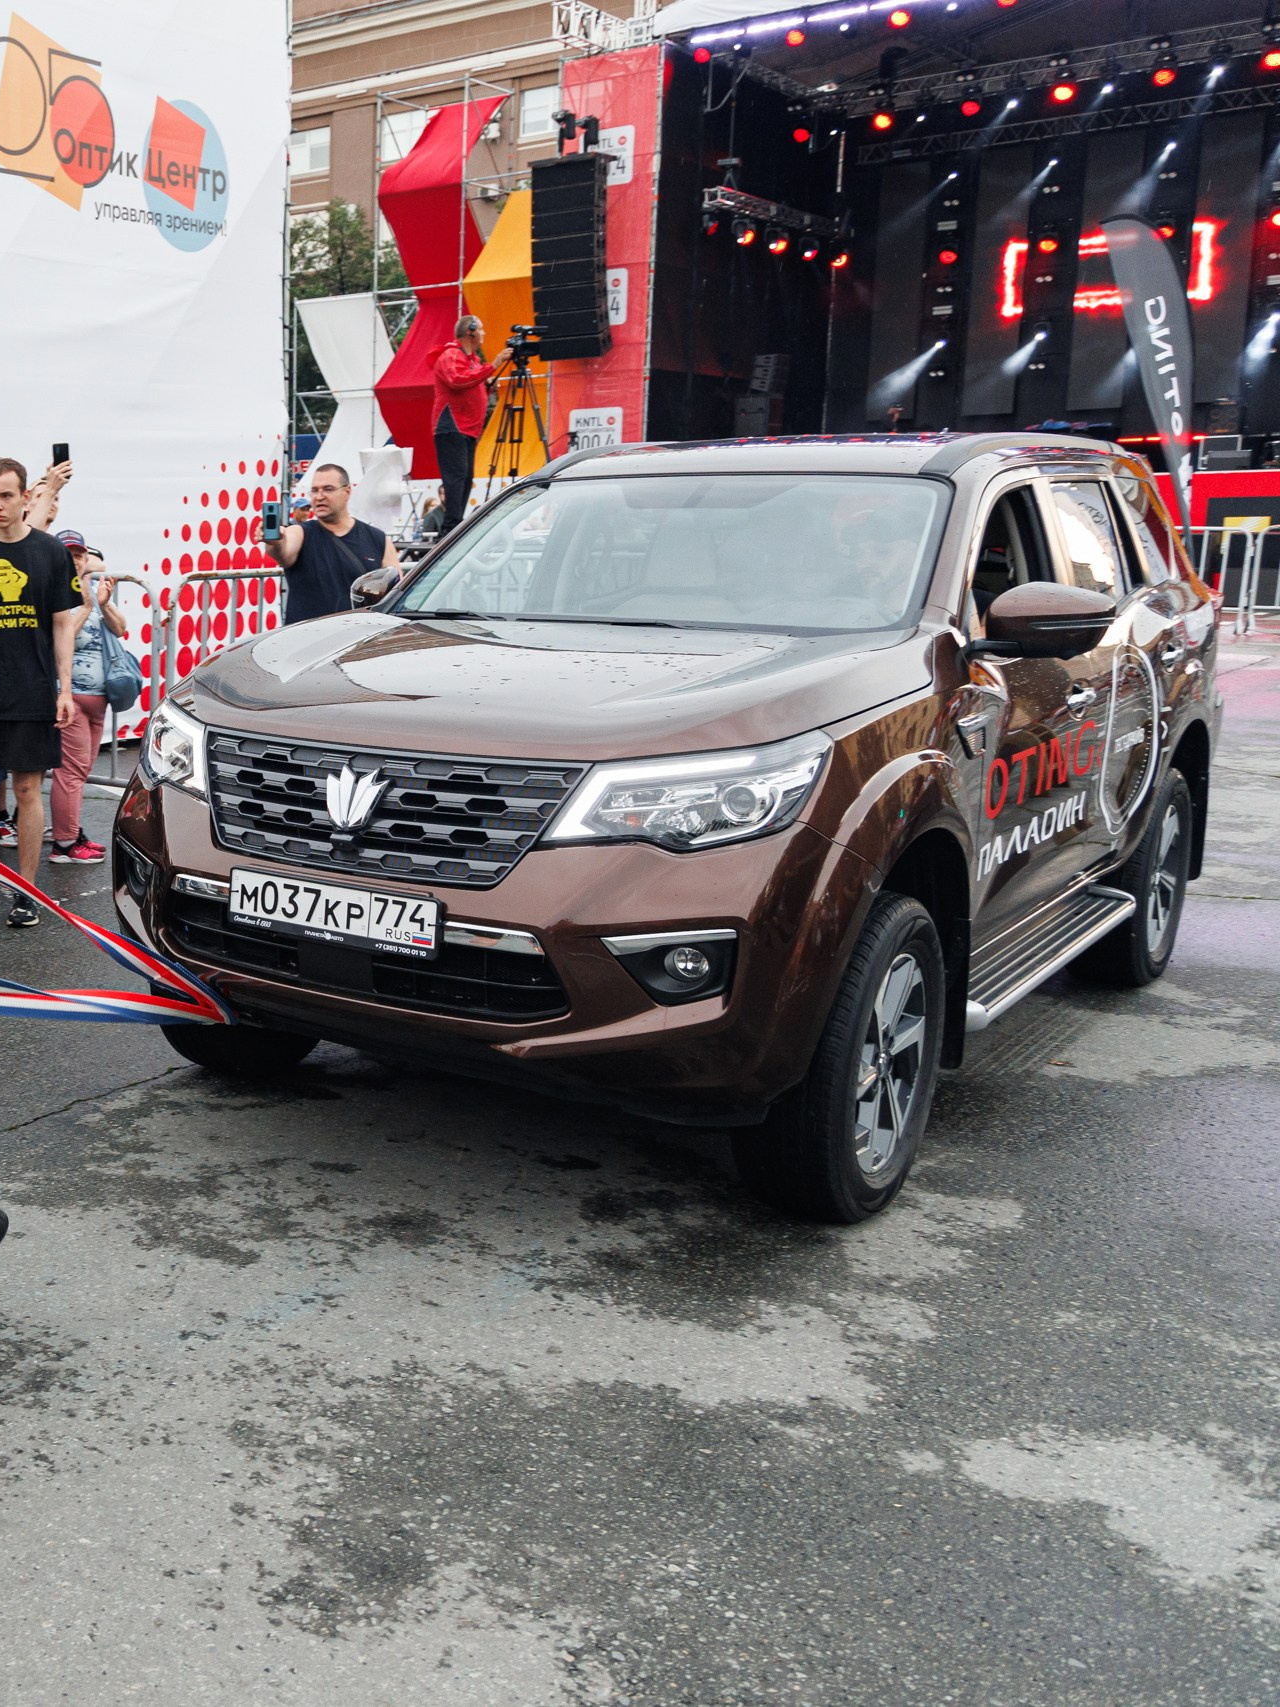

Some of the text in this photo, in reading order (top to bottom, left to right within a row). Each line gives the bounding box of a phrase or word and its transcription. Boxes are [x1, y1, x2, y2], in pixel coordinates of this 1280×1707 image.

[54, 128, 227, 202] Оптик Центр
[94, 201, 228, 237] управляя зрением!
[575, 416, 603, 427] KNTL
[984, 719, 1097, 820] OTING
[976, 790, 1087, 882] ПАЛАДИН
[373, 896, 426, 932] 774
[383, 943, 398, 953] (351)
[398, 946, 410, 954] 700
[385, 928, 411, 942] RUS
